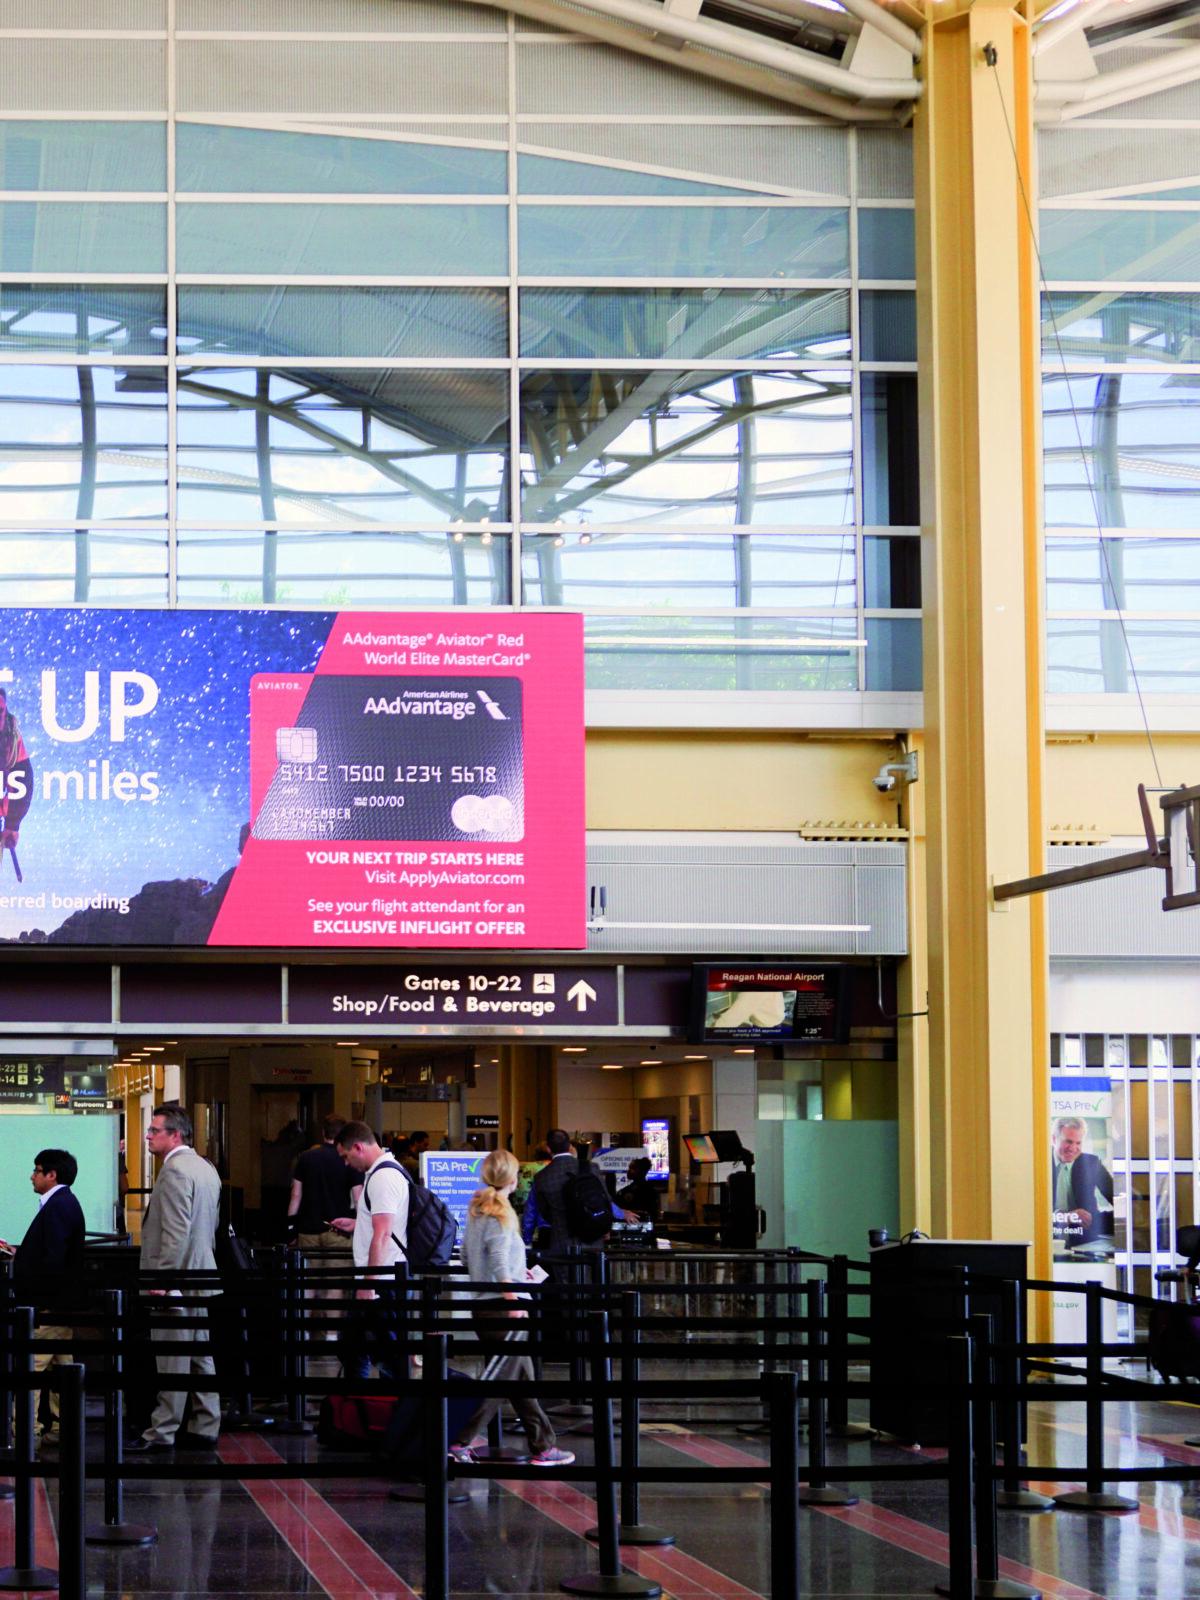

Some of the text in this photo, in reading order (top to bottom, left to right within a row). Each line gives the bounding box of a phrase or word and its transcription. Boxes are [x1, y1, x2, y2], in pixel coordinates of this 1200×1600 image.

[497, 634, 524, 647] Red
[365, 652, 406, 665] World
[411, 652, 440, 665] Elite
[403, 690, 468, 699] American Airlines
[42, 670, 159, 742] UP
[364, 698, 476, 720] AAdvantage
[43, 760, 159, 800] miles
[280, 765, 497, 783] 5412 7500 1234 5678
[369, 796, 404, 807] 00/00
[272, 808, 351, 819] CARDMEMBER
[307, 852, 524, 865] YOUR NEXT TRIP STARTS HERE
[365, 870, 524, 888] Visit ApplyAviator.com
[51, 893, 130, 913] boarding
[308, 899, 524, 915] See your flight attendant for an
[314, 920, 525, 935] EXCLUSIVE INFLIGHT OFFER
[404, 975, 522, 991] Gates 10-22
[722, 973, 824, 983] Reagan National Airport
[332, 995, 555, 1017] Shop/Food & Beverage
[439, 1090, 445, 1099] 2
[1053, 1101, 1091, 1110] TSA Pre
[430, 1161, 468, 1172] TSA Pre
[1064, 1227, 1083, 1235] deal]
